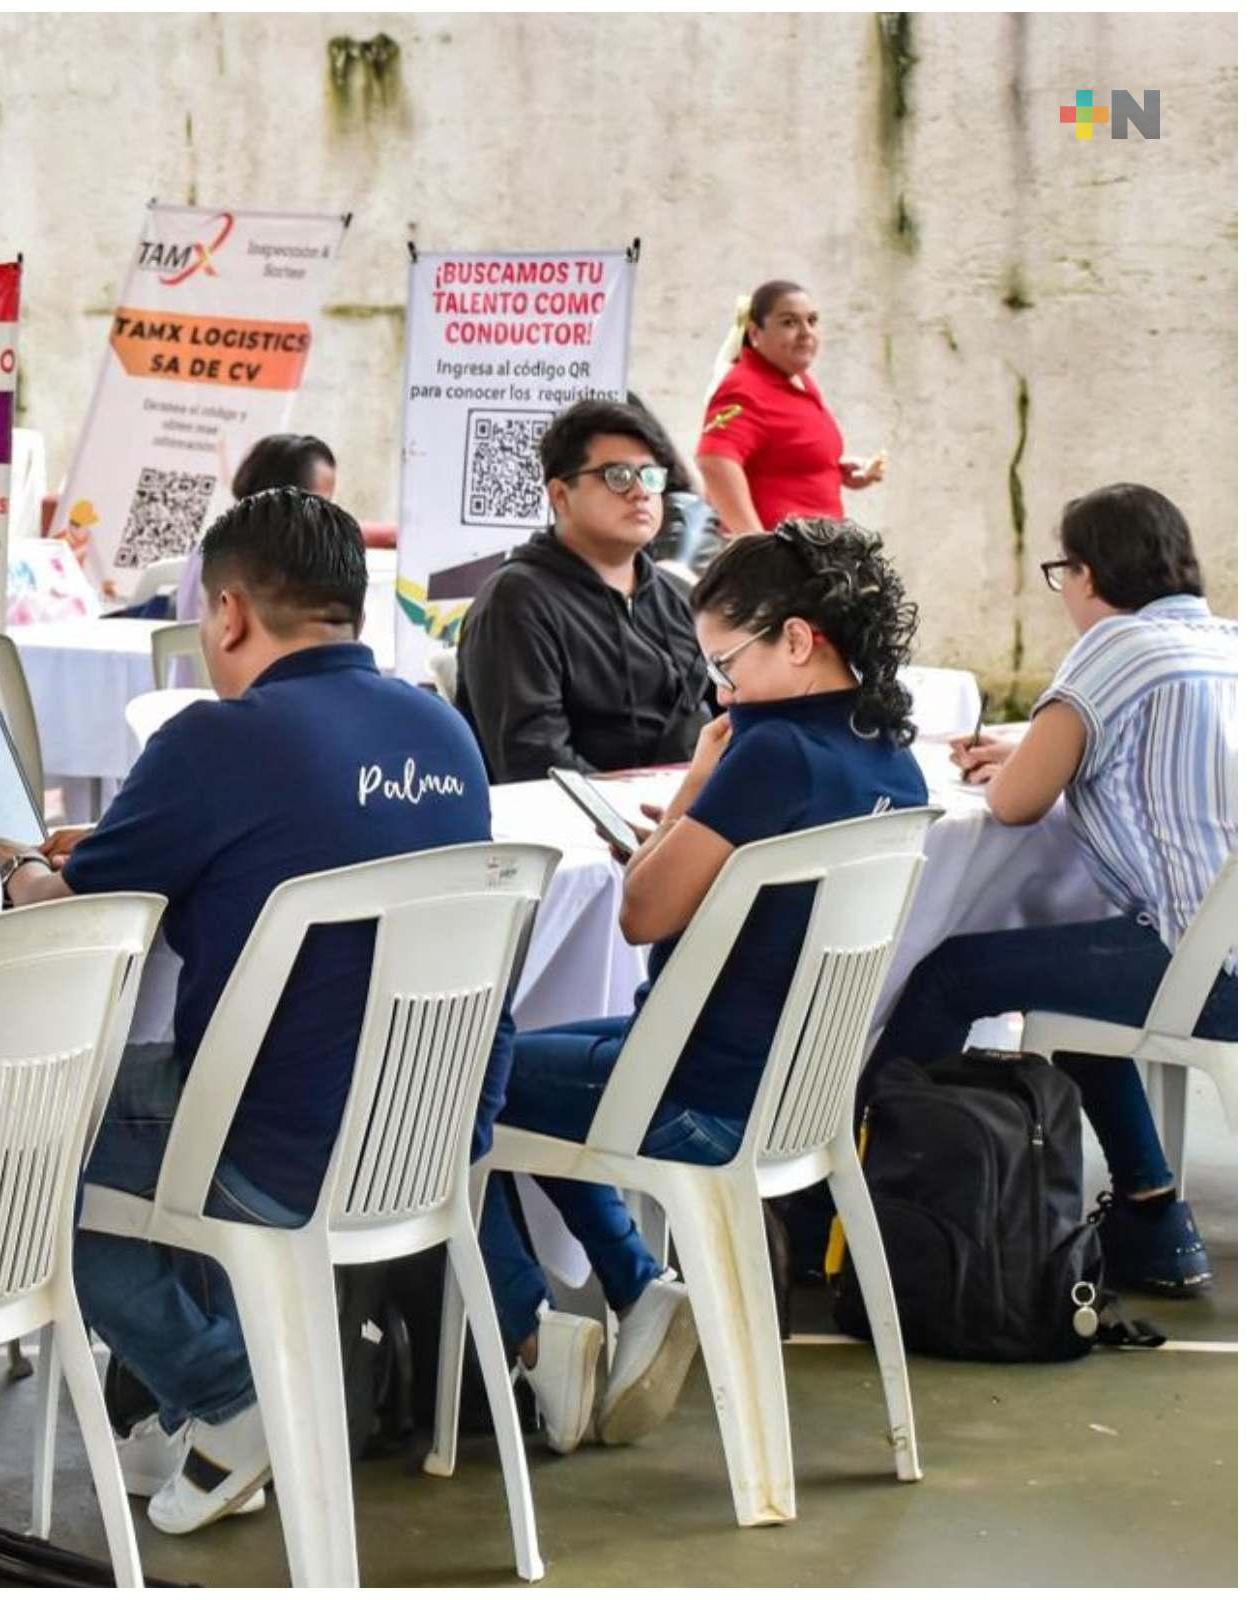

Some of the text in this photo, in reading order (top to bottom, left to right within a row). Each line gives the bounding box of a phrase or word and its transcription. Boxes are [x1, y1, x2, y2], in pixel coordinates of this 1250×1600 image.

[138, 212, 234, 287] TAMX
[436, 262, 603, 288] ¡BUSCAMOS TU
[433, 292, 527, 314] TALENTO
[114, 317, 310, 354] TAMX LOGISTICS
[445, 322, 593, 346] CONDUCTOR!
[150, 354, 262, 381] SA DE CV
[437, 359, 590, 381] Ingresa al código QR
[411, 386, 442, 400] para
[446, 386, 507, 400] conocer
[510, 384, 530, 400] los
[357, 757, 464, 806] Palma
